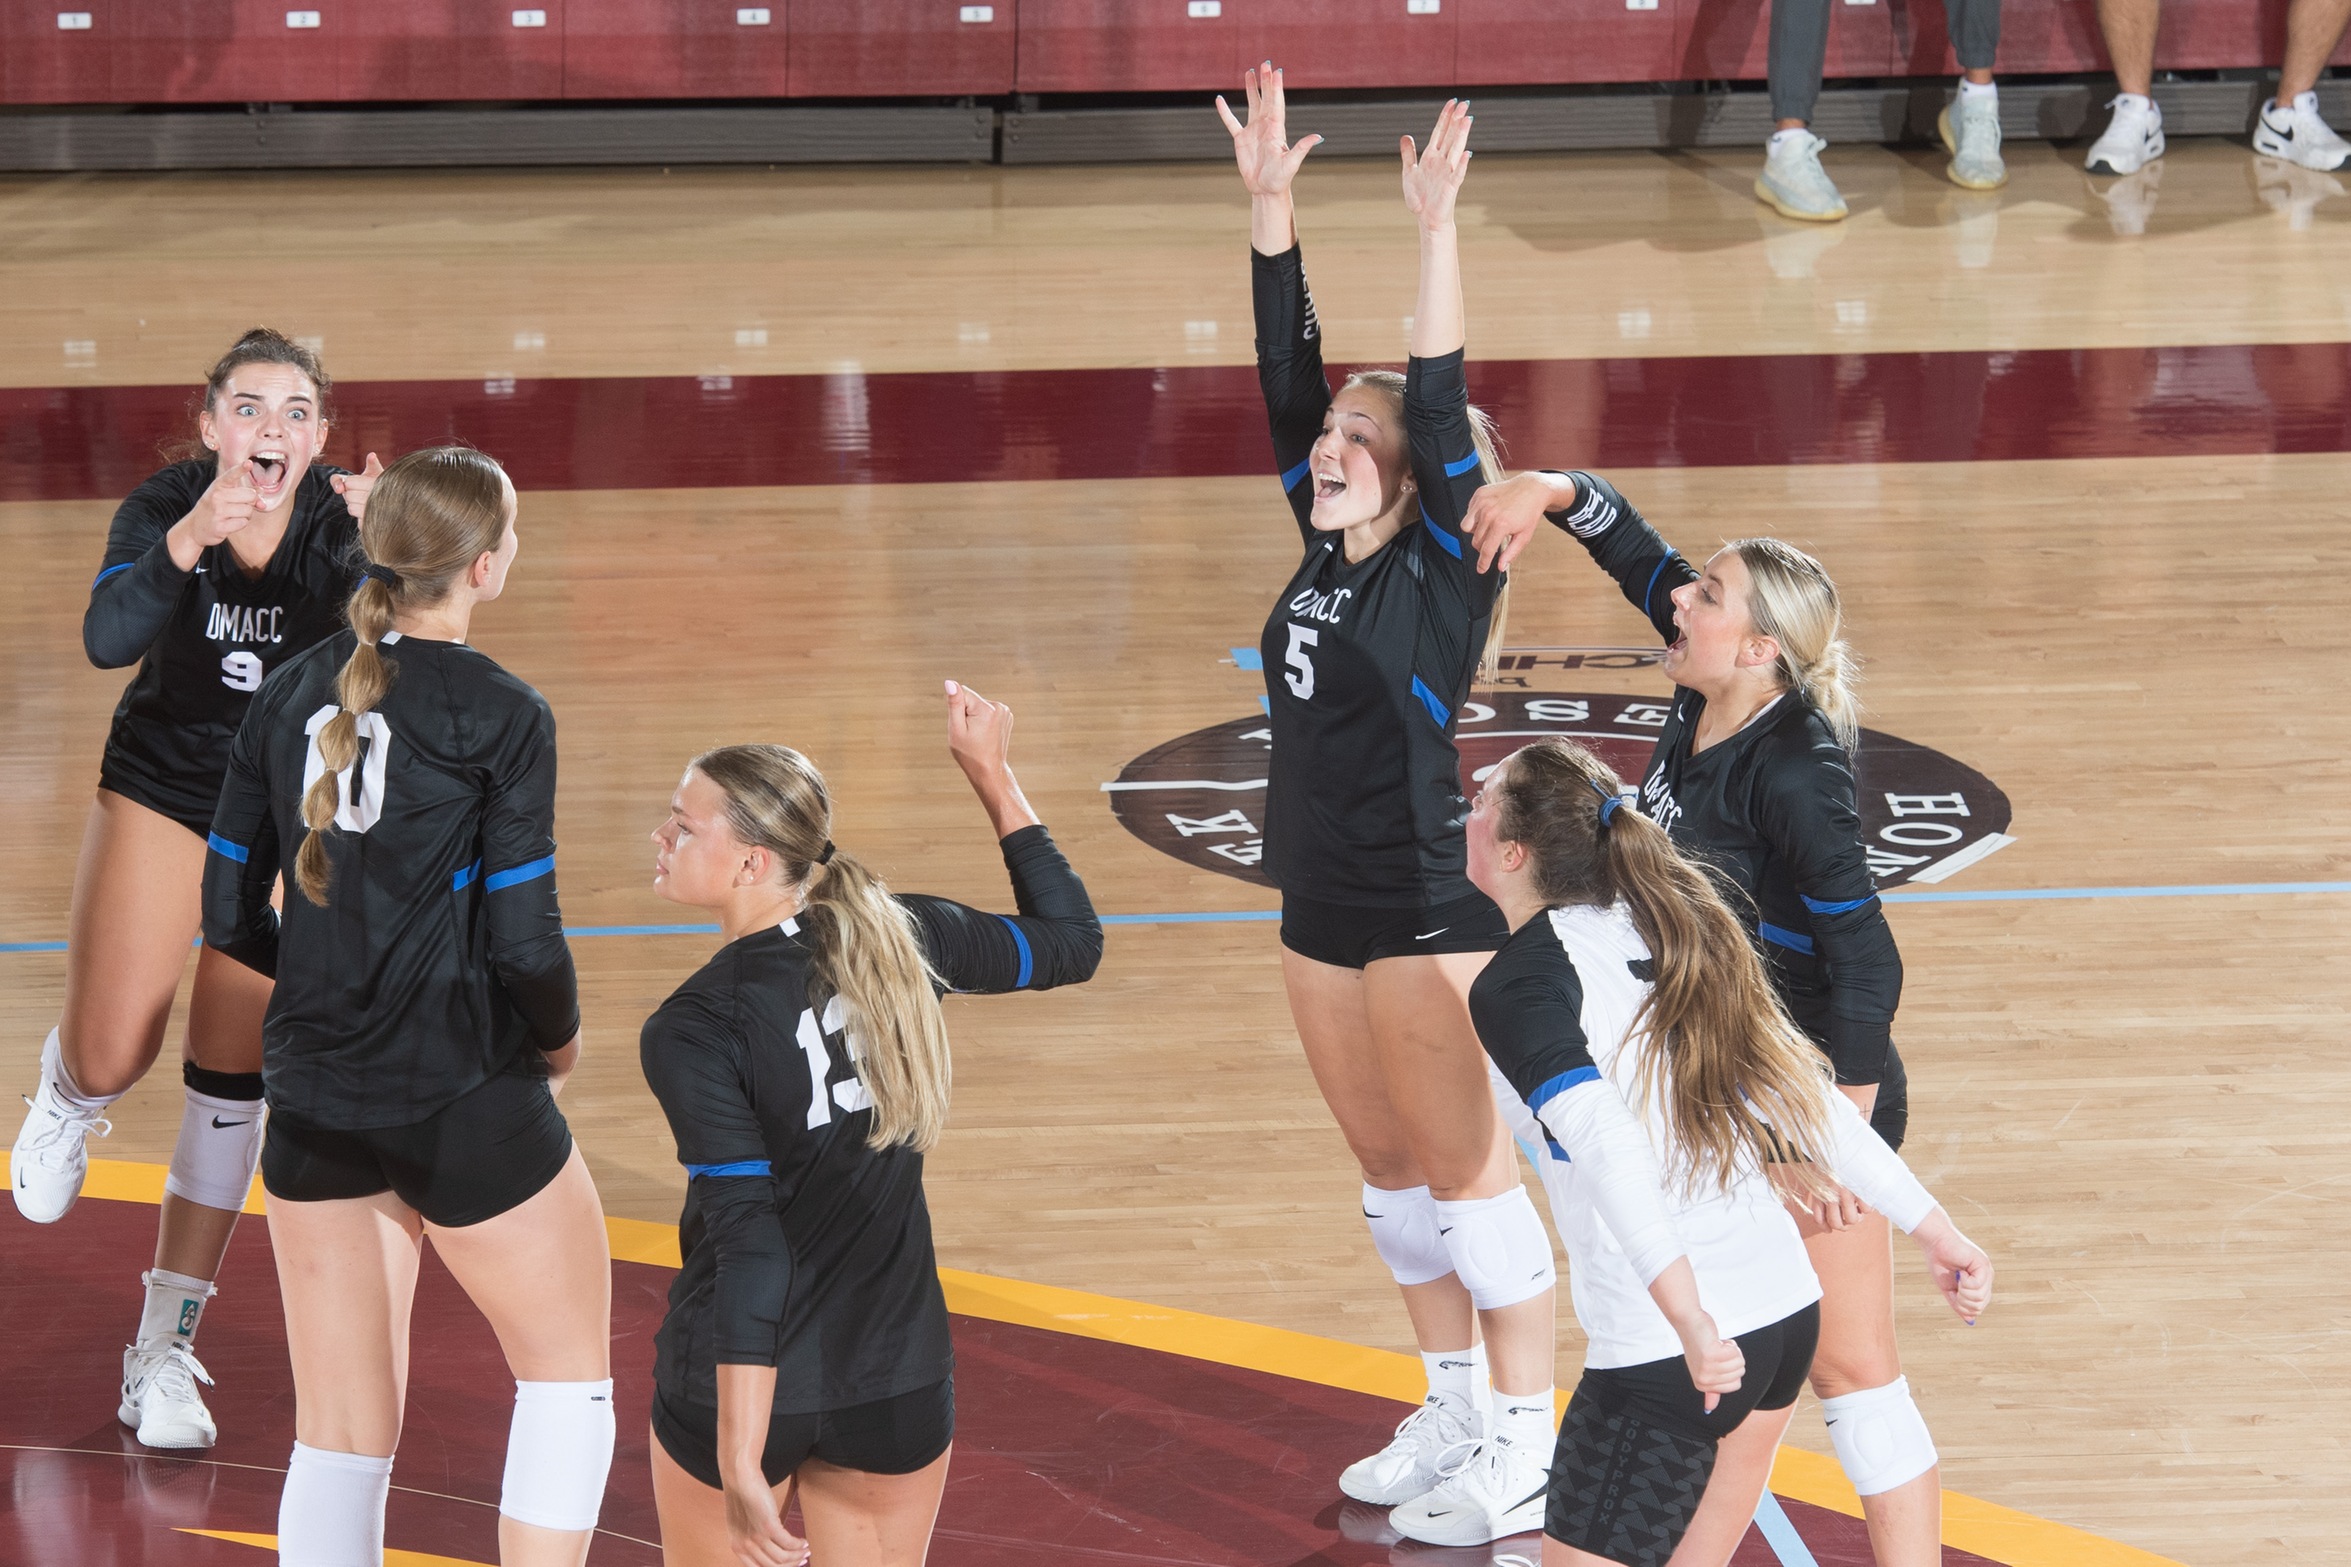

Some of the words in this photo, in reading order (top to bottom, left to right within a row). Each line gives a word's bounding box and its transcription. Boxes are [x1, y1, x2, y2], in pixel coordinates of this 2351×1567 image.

[205, 603, 283, 643] DMACC
[221, 651, 262, 692] 9
[1284, 621, 1318, 700] 5
[303, 704, 392, 834] 10
[1494, 1434, 1513, 1448] NIKE
